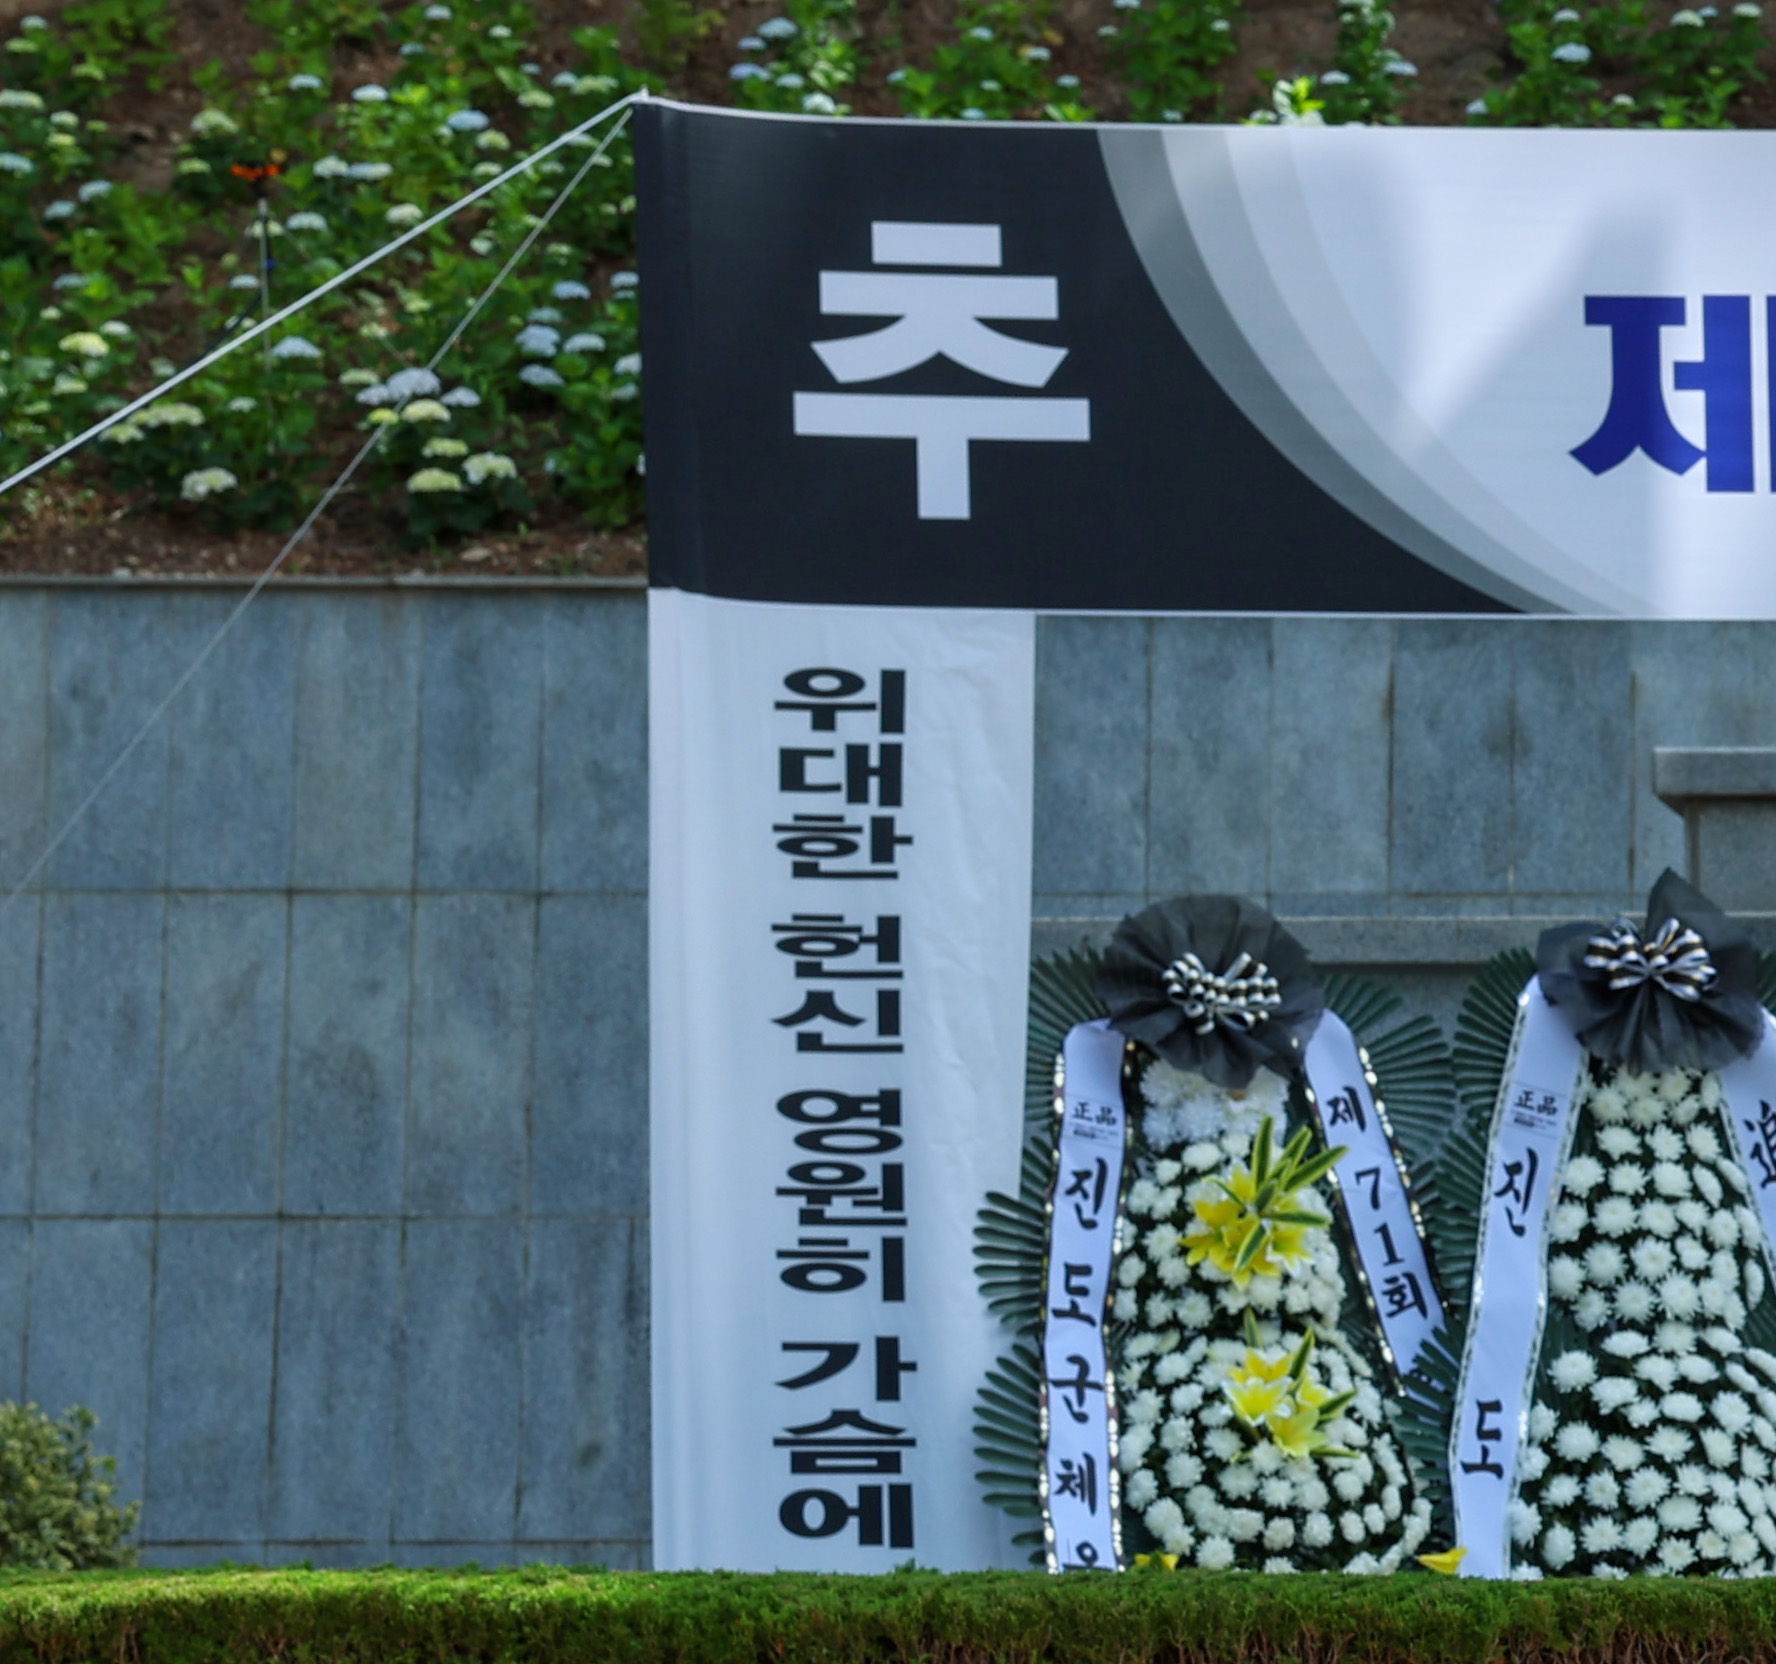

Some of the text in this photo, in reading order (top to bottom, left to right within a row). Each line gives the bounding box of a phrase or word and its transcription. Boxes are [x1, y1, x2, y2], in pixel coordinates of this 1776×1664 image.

[793, 222, 1090, 519] 추
[771, 667, 918, 1550] 위대한 헌신 영원히 가슴에
